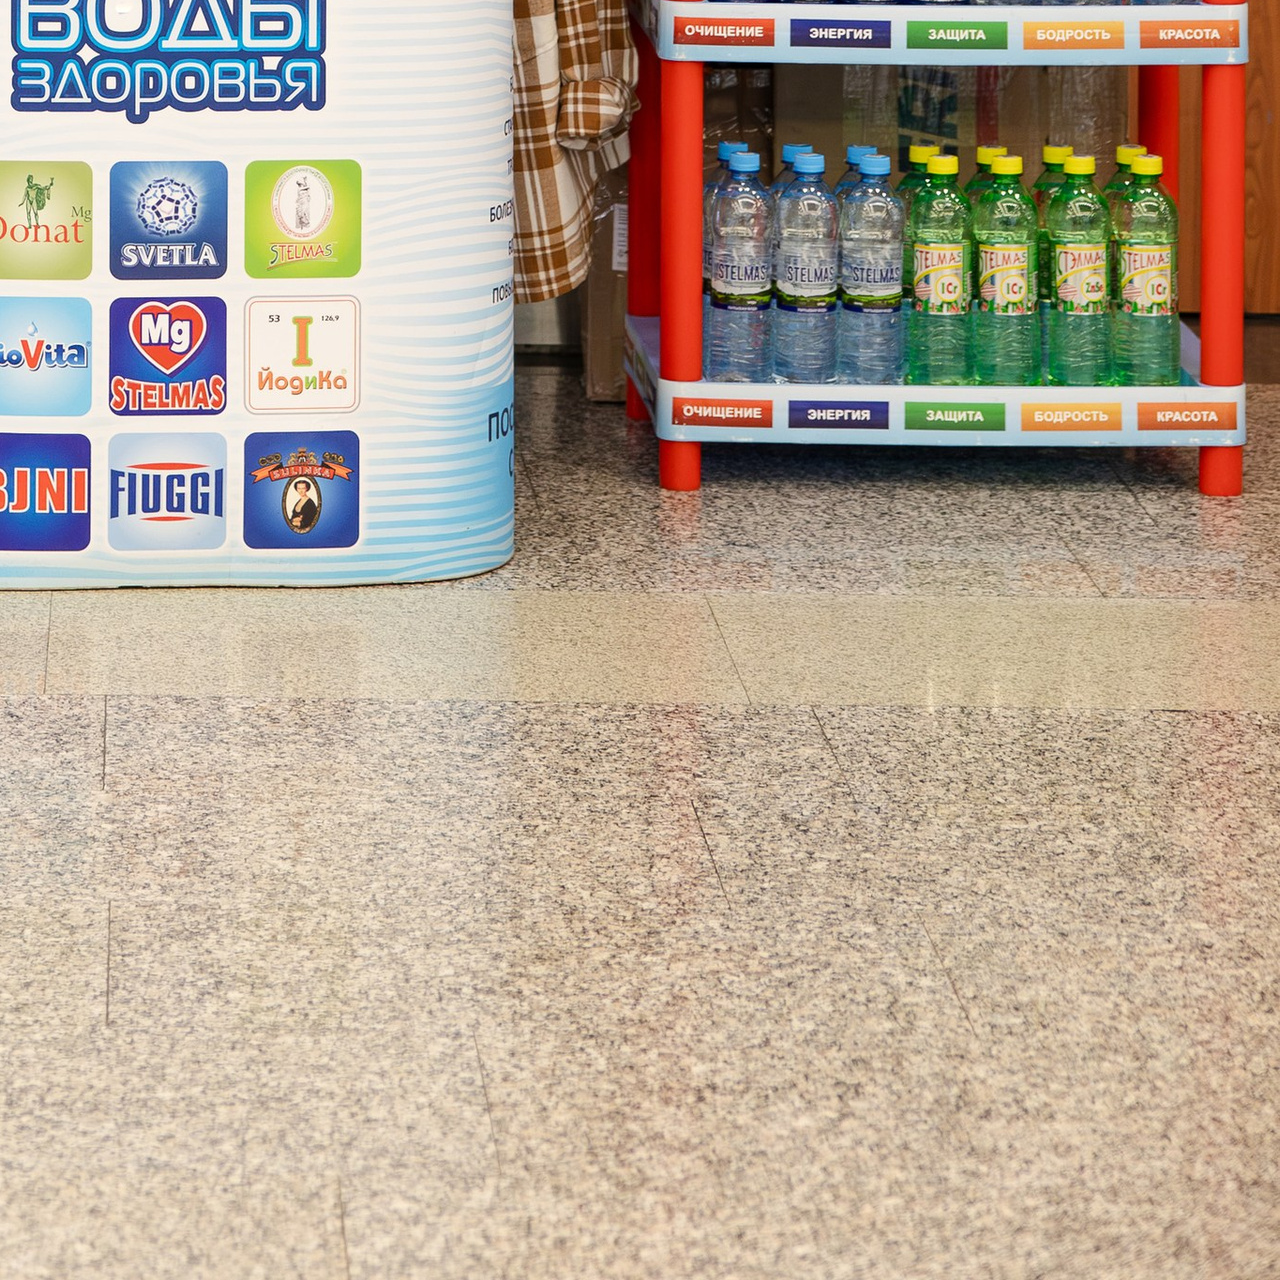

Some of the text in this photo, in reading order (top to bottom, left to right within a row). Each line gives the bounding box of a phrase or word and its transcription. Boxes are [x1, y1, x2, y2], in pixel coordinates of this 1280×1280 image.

[684, 24, 1220, 41] ОЧИЩЕНИЕ ЭНЕРГИЯ ЗАЩИТА БОДРОСТЬ КРАСОТА
[71, 206, 92, 222] Mg
[122, 242, 219, 267] SVETLA
[270, 243, 333, 264] STELMAS
[719, 264, 766, 281] STELMAS
[787, 265, 834, 283] STELMAS
[853, 267, 900, 283] STELMAS
[268, 314, 281, 322] 53
[141, 313, 191, 353] Mg
[111, 375, 225, 410] STELMAS
[683, 405, 1218, 423] ОЧИЩЕНИЕ ЭНЕРГИЯ ЗАЩИТА БОДРОСТЬ КРАСОТА
[110, 468, 223, 519] FIUGGI
